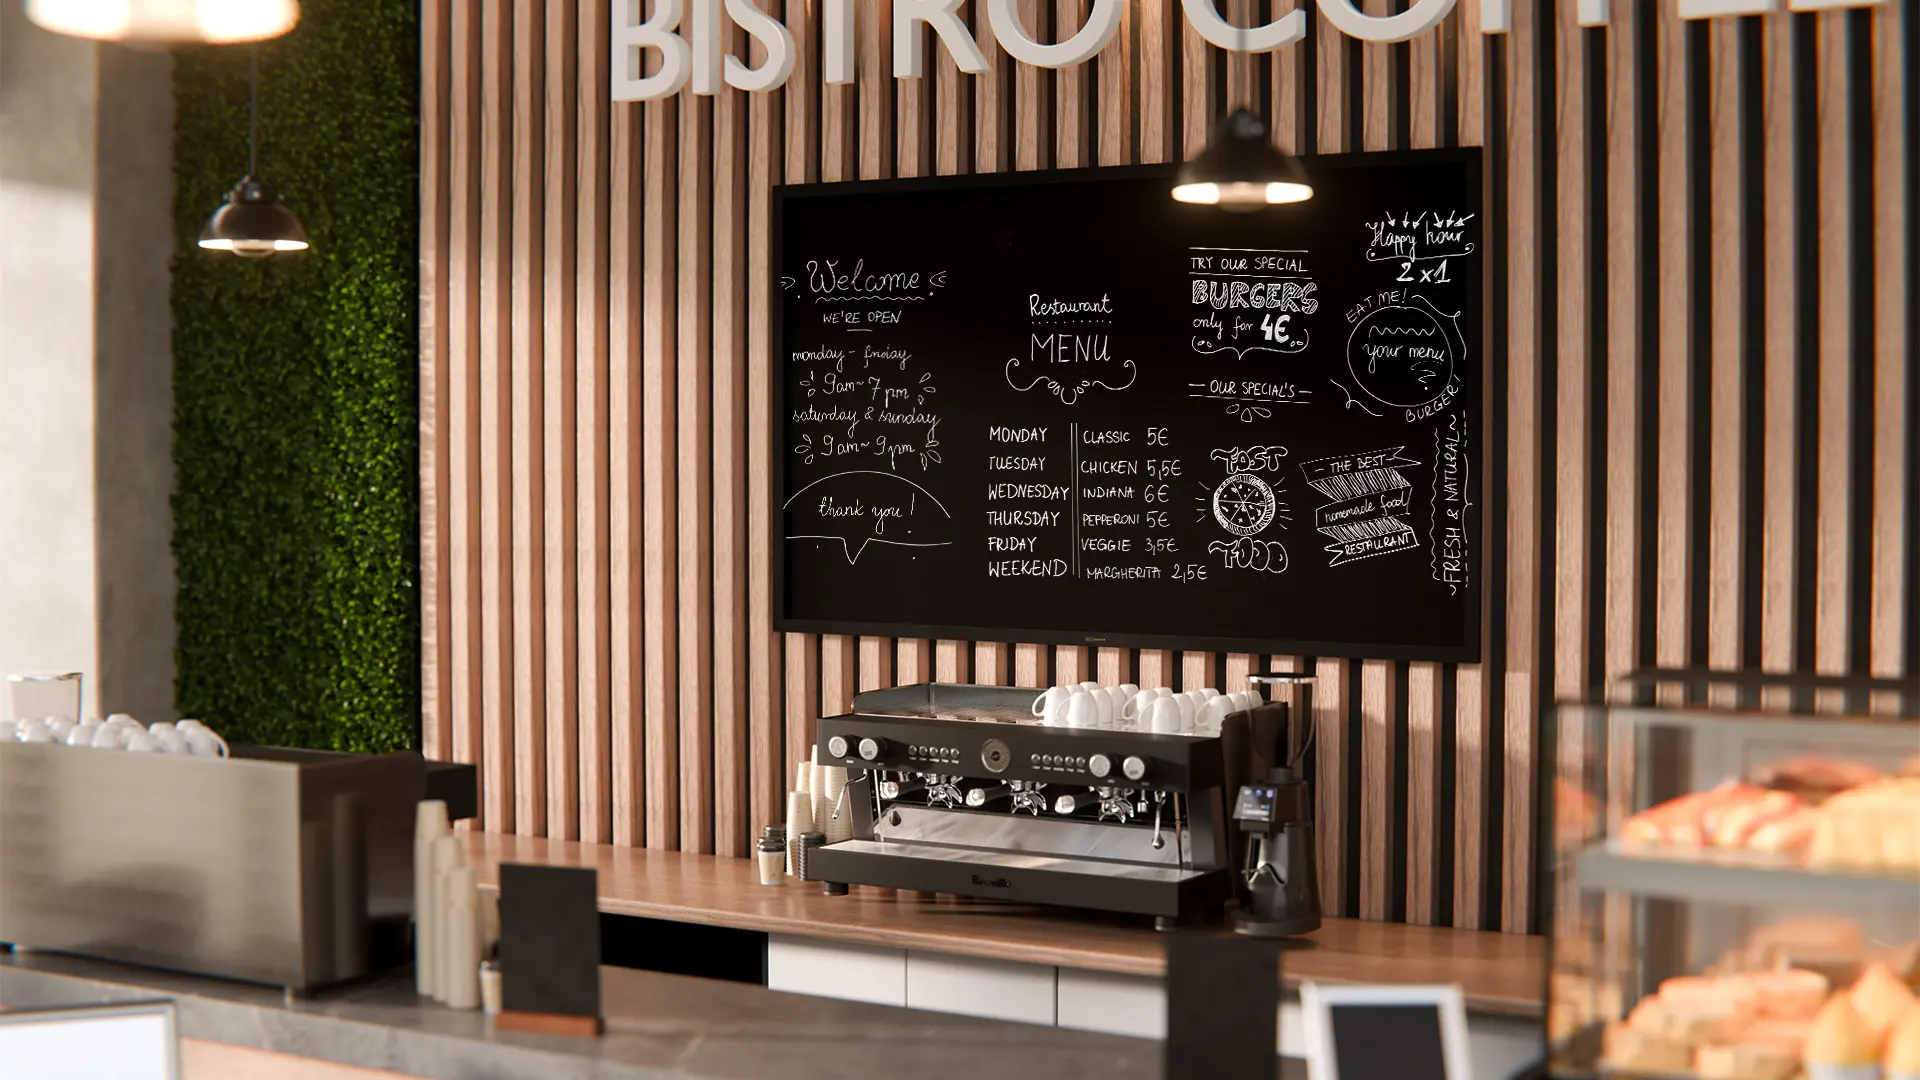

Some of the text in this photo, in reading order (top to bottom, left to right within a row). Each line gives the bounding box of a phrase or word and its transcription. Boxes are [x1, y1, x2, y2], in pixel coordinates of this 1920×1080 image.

[1365, 220, 1464, 262] Happy hour
[1191, 257, 1307, 272] TRY OUR SPECIAL
[807, 258, 920, 293] Welcome
[1030, 294, 1112, 316] Restaurant
[1192, 280, 1318, 314] BURGERS
[1346, 288, 1407, 323] EAT ME!
[824, 311, 901, 323] WE'RE OPEN
[1193, 312, 1291, 343] only for 4€
[792, 344, 845, 373] monday
[864, 345, 911, 370] friday
[1031, 334, 1110, 363] MENU
[1363, 344, 1445, 373] your menu
[1210, 380, 1294, 397] OUR SPECIAL'S
[793, 404, 859, 438] saturday
[878, 407, 941, 443] sunday
[990, 426, 1047, 442] MONDAY
[1083, 428, 1168, 446] CLASSIC 5€
[990, 456, 1045, 470] TUESDAY
[1210, 445, 1288, 474] FAST
[1330, 454, 1386, 474] THE BEST
[1444, 430, 1460, 501] NATURAL
[1081, 460, 1181, 480] CHICKEN 5,5€
[989, 484, 1069, 500] WEDNESDAY
[1084, 486, 1134, 498] INDIANA
[819, 497, 864, 517] thank
[1325, 491, 1408, 523] homemade food
[986, 511, 1060, 526] THURSDAY
[1083, 511, 1170, 527] PEPPERONI 5€
[988, 537, 1037, 552] FRIDAY
[1082, 538, 1178, 555] VEGGIE 3,5€
[1344, 531, 1410, 556] RESTAURANT
[1208, 536, 1288, 573] FOOD
[1443, 528, 1461, 582] FRESH
[989, 559, 1067, 577] WEEKEND
[1087, 564, 1207, 583] MARGHERITA 2,5€
